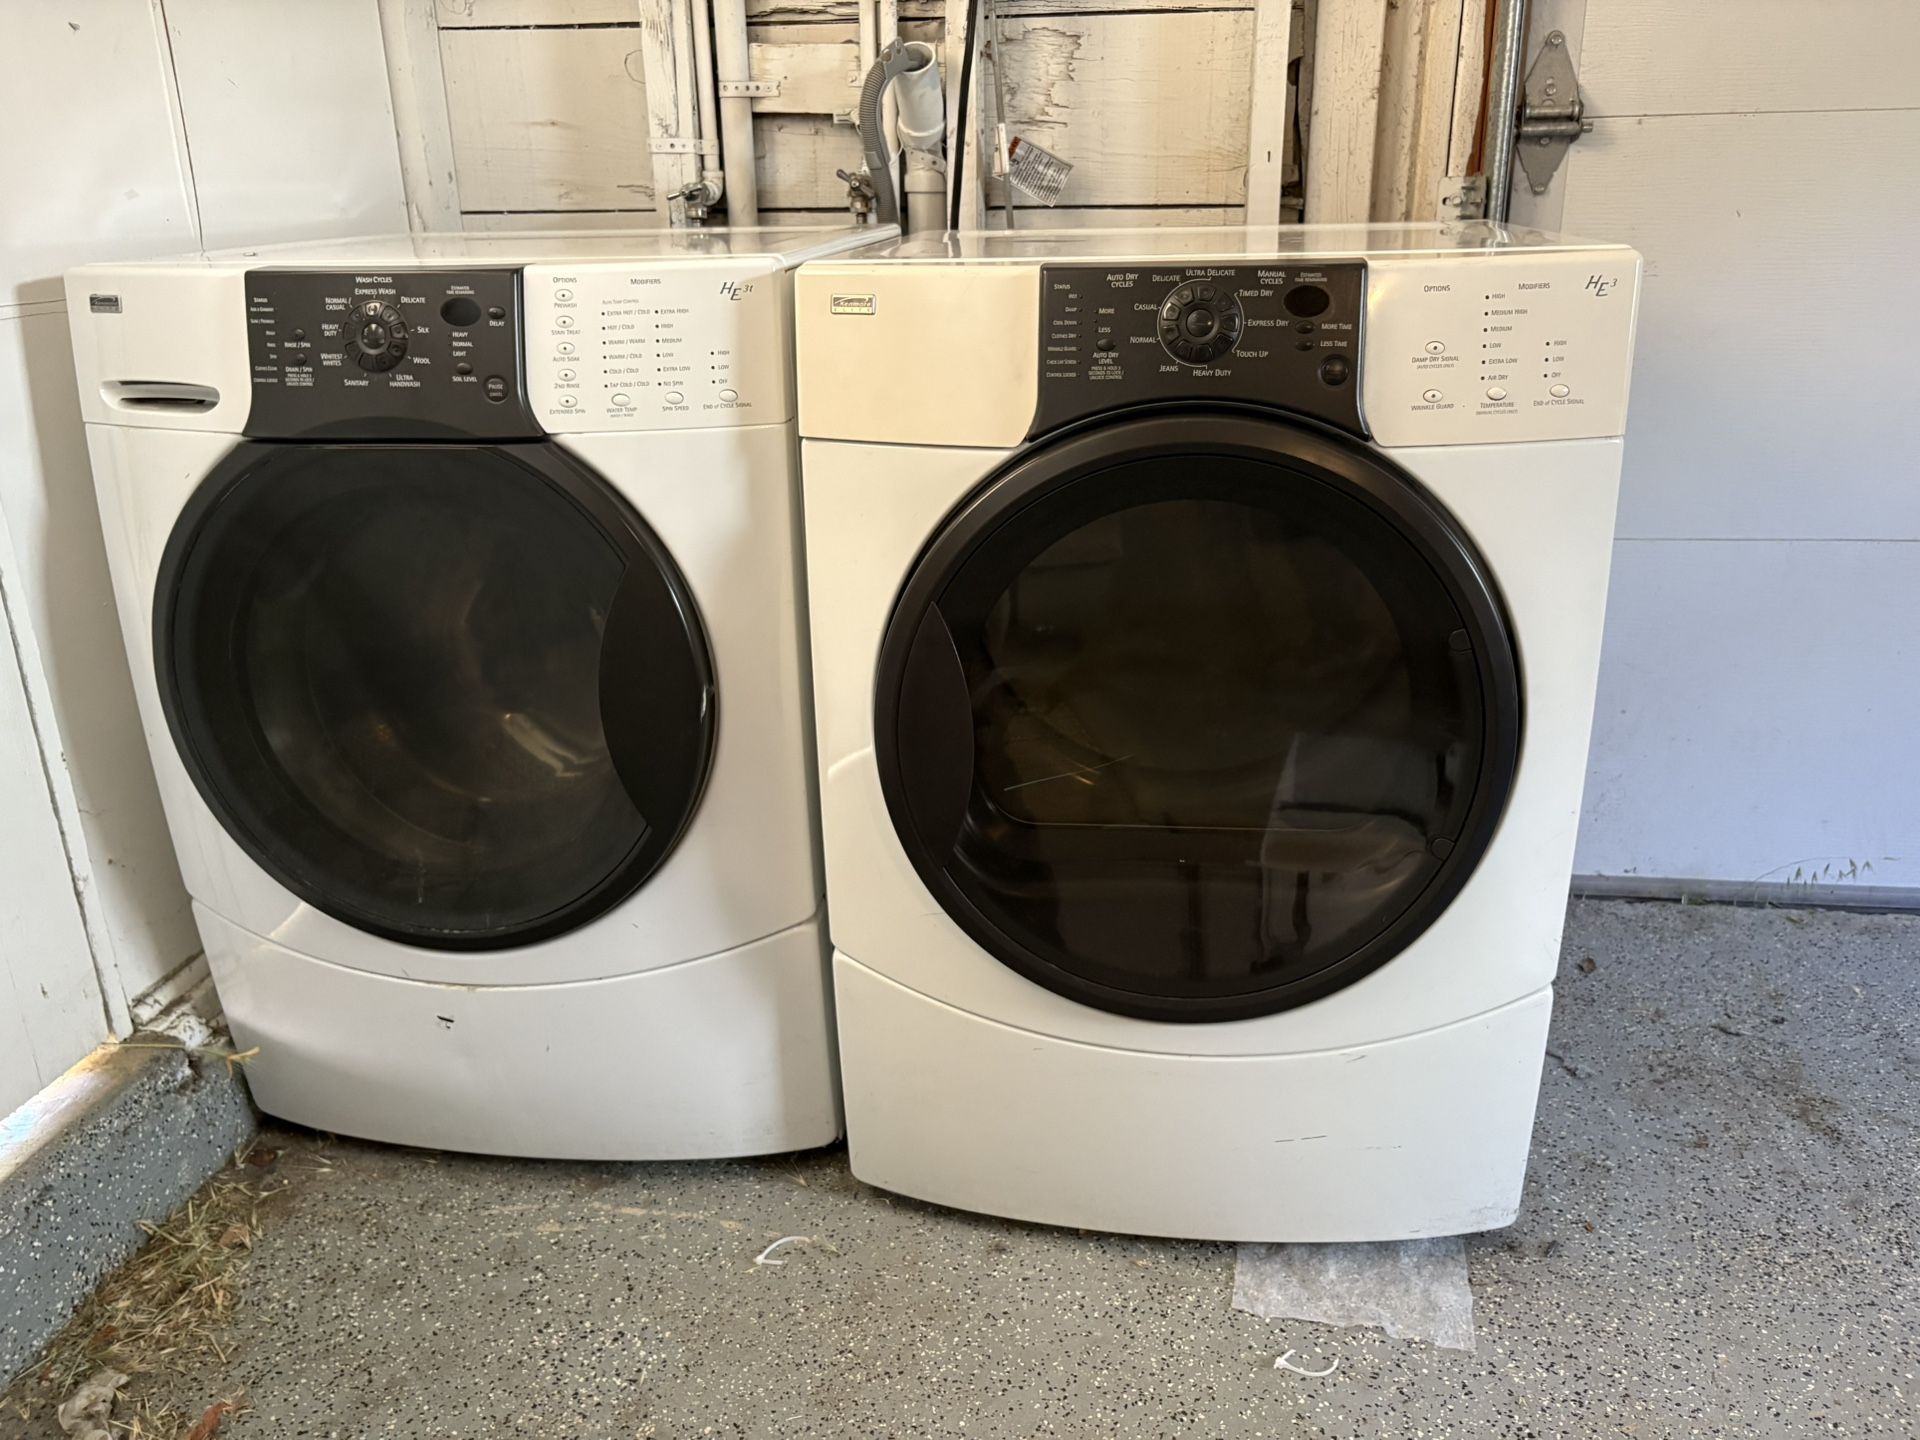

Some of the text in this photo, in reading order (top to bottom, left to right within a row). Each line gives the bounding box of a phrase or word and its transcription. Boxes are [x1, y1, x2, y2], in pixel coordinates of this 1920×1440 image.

[1186, 269, 1206, 277] ULTRA
[1258, 270, 1286, 278] MANUAL
[1134, 303, 1157, 311] CASUAL
[1248, 319, 1289, 327] EXPRESS DRY
[1130, 336, 1157, 344] NORMAL
[1236, 350, 1258, 358] TOUCH
[1193, 369, 1214, 377] HEAVY
